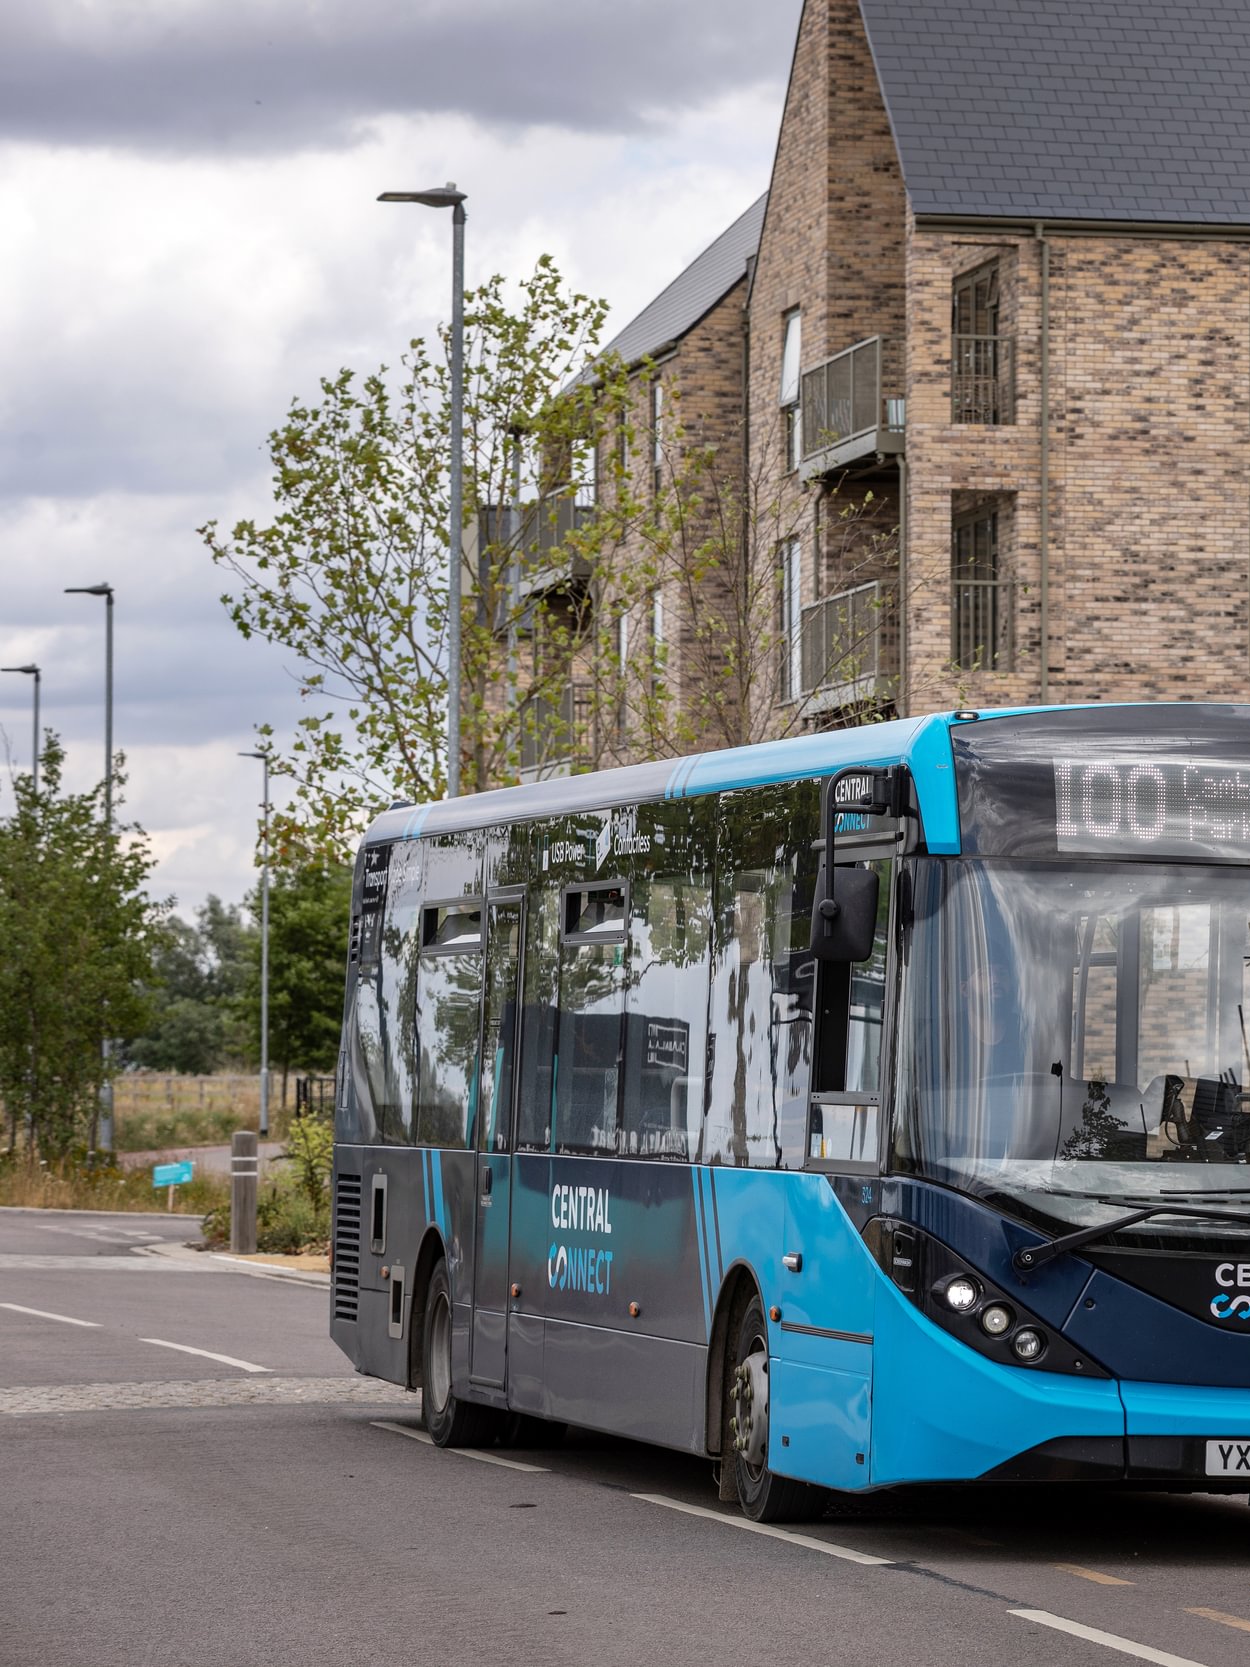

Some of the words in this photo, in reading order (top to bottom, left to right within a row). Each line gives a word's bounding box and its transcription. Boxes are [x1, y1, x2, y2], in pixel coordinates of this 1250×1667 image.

[835, 776, 869, 802] CENTRAL
[1055, 760, 1166, 839] 100
[551, 841, 564, 864] USB
[565, 841, 585, 861] Power
[614, 830, 651, 856] Contactless
[861, 1186, 873, 1204] 324
[551, 1184, 612, 1234] CENTRAL
[548, 1241, 613, 1295] CONNECT
